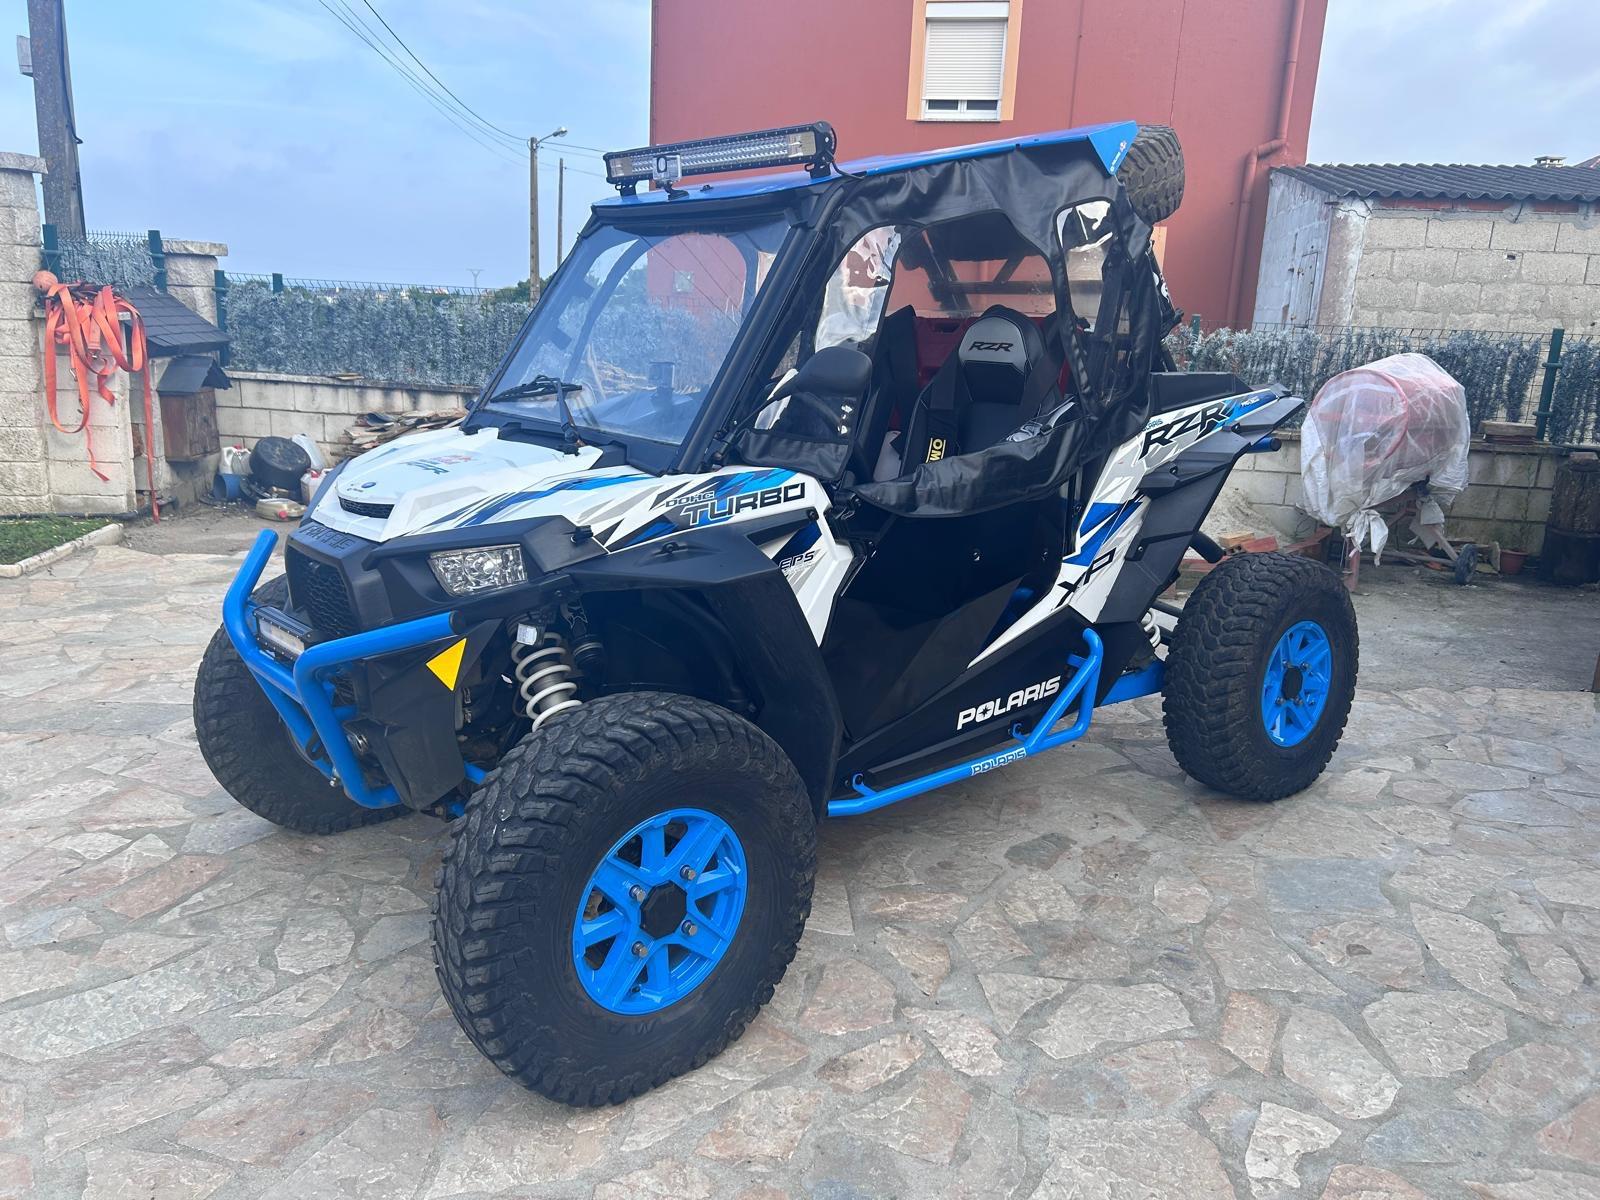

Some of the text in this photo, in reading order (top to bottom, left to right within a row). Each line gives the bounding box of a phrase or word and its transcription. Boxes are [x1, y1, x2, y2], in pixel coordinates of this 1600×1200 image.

[968, 341, 1014, 352] RZR
[1137, 402, 1229, 460] RZR
[665, 490, 715, 507] DOHC
[681, 482, 806, 526] TURBO
[780, 550, 816, 569] EPS
[1055, 547, 1117, 608] XP
[957, 675, 1061, 730] POLARIS
[971, 747, 1027, 776] POLARIS
